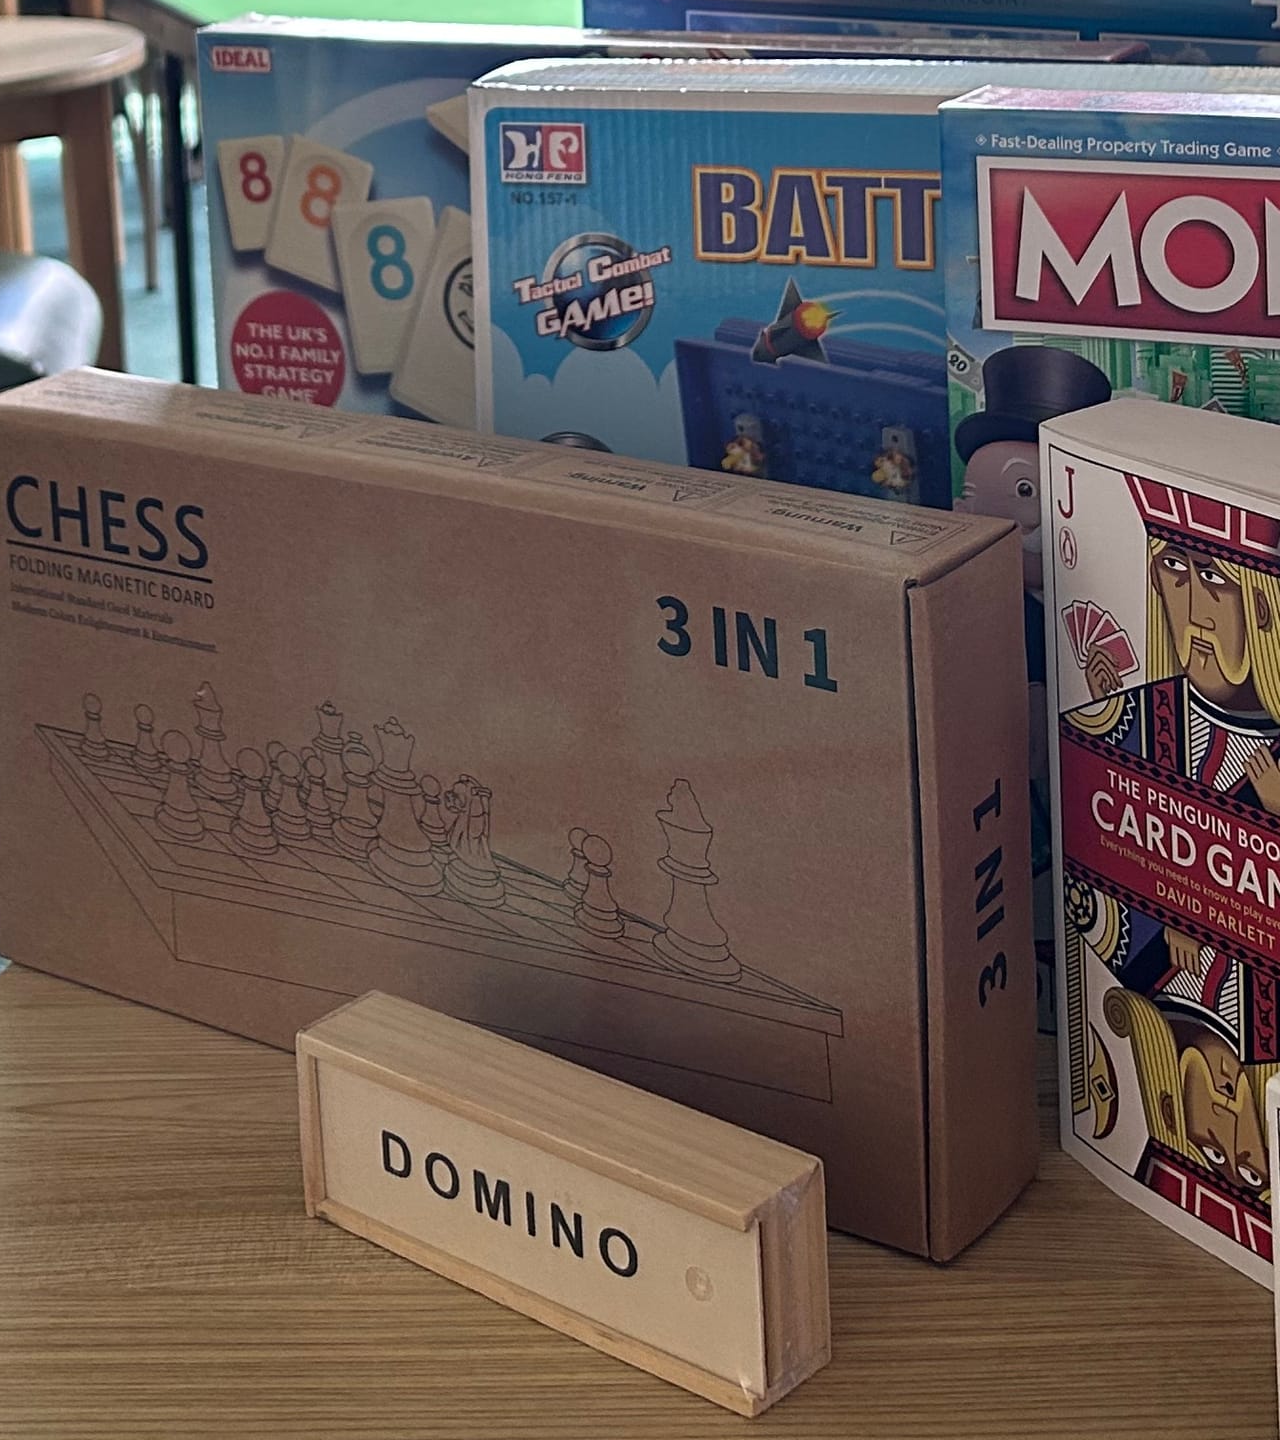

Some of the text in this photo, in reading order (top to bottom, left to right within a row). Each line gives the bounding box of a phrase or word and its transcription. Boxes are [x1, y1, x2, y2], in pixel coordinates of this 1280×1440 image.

[215, 51, 268, 68] IDEAL
[240, 152, 272, 203] 8
[505, 172, 582, 181] HONG FENG
[991, 133, 1272, 159] Fast-Dealing Property Trading Game
[300, 164, 342, 229] 8
[691, 166, 940, 271] BATT
[367, 224, 414, 301] 8
[588, 246, 671, 283] Combat
[247, 322, 327, 342] THE UK'S
[280, 347, 342, 364] FAMILY
[244, 364, 335, 383] STRATEGY
[6, 475, 209, 570] CHESS
[9, 554, 214, 609] FOLDING MAGNETIC BOARD
[656, 596, 838, 693] 3 IN 1
[1091, 790, 1197, 868] CARD
[1107, 769, 1141, 801] THE
[1147, 788, 1231, 842] PENGUIN
[973, 779, 1007, 1008] 3 IN 1
[1100, 835, 1146, 868] Everything
[1148, 859, 1164, 876] you
[1164, 865, 1189, 887] need
[1190, 877, 1201, 891] to
[1203, 881, 1228, 906] know
[1230, 896, 1241, 910] to
[1243, 902, 1263, 924] play
[1156, 880, 1276, 951] DAVID PARLETT
[382, 1130, 638, 1278] DOMINO
